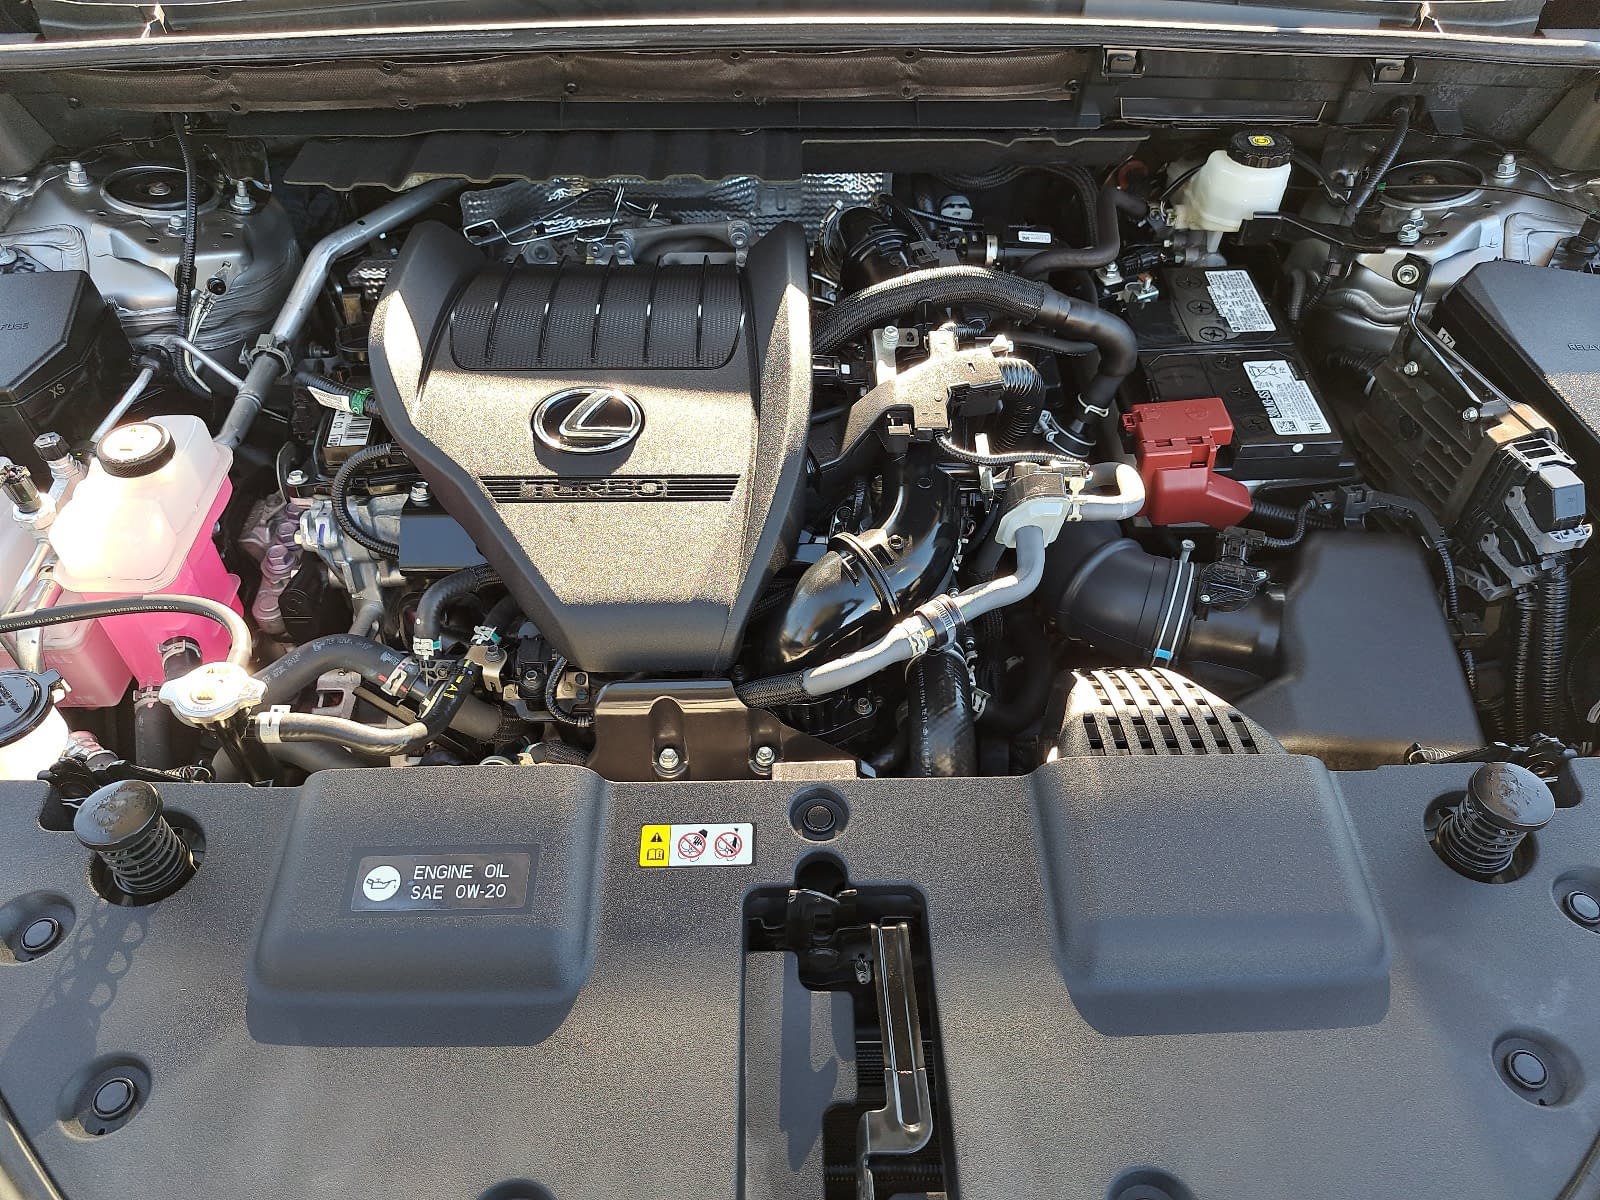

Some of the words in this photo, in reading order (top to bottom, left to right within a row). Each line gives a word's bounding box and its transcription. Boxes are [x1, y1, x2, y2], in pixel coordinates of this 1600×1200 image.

[1441, 333, 1453, 346] 17
[48, 383, 66, 399] XS
[413, 864, 474, 880] ENGINE
[484, 863, 510, 879] OIL
[410, 884, 445, 900] SAE
[455, 883, 507, 899] 0W-20
